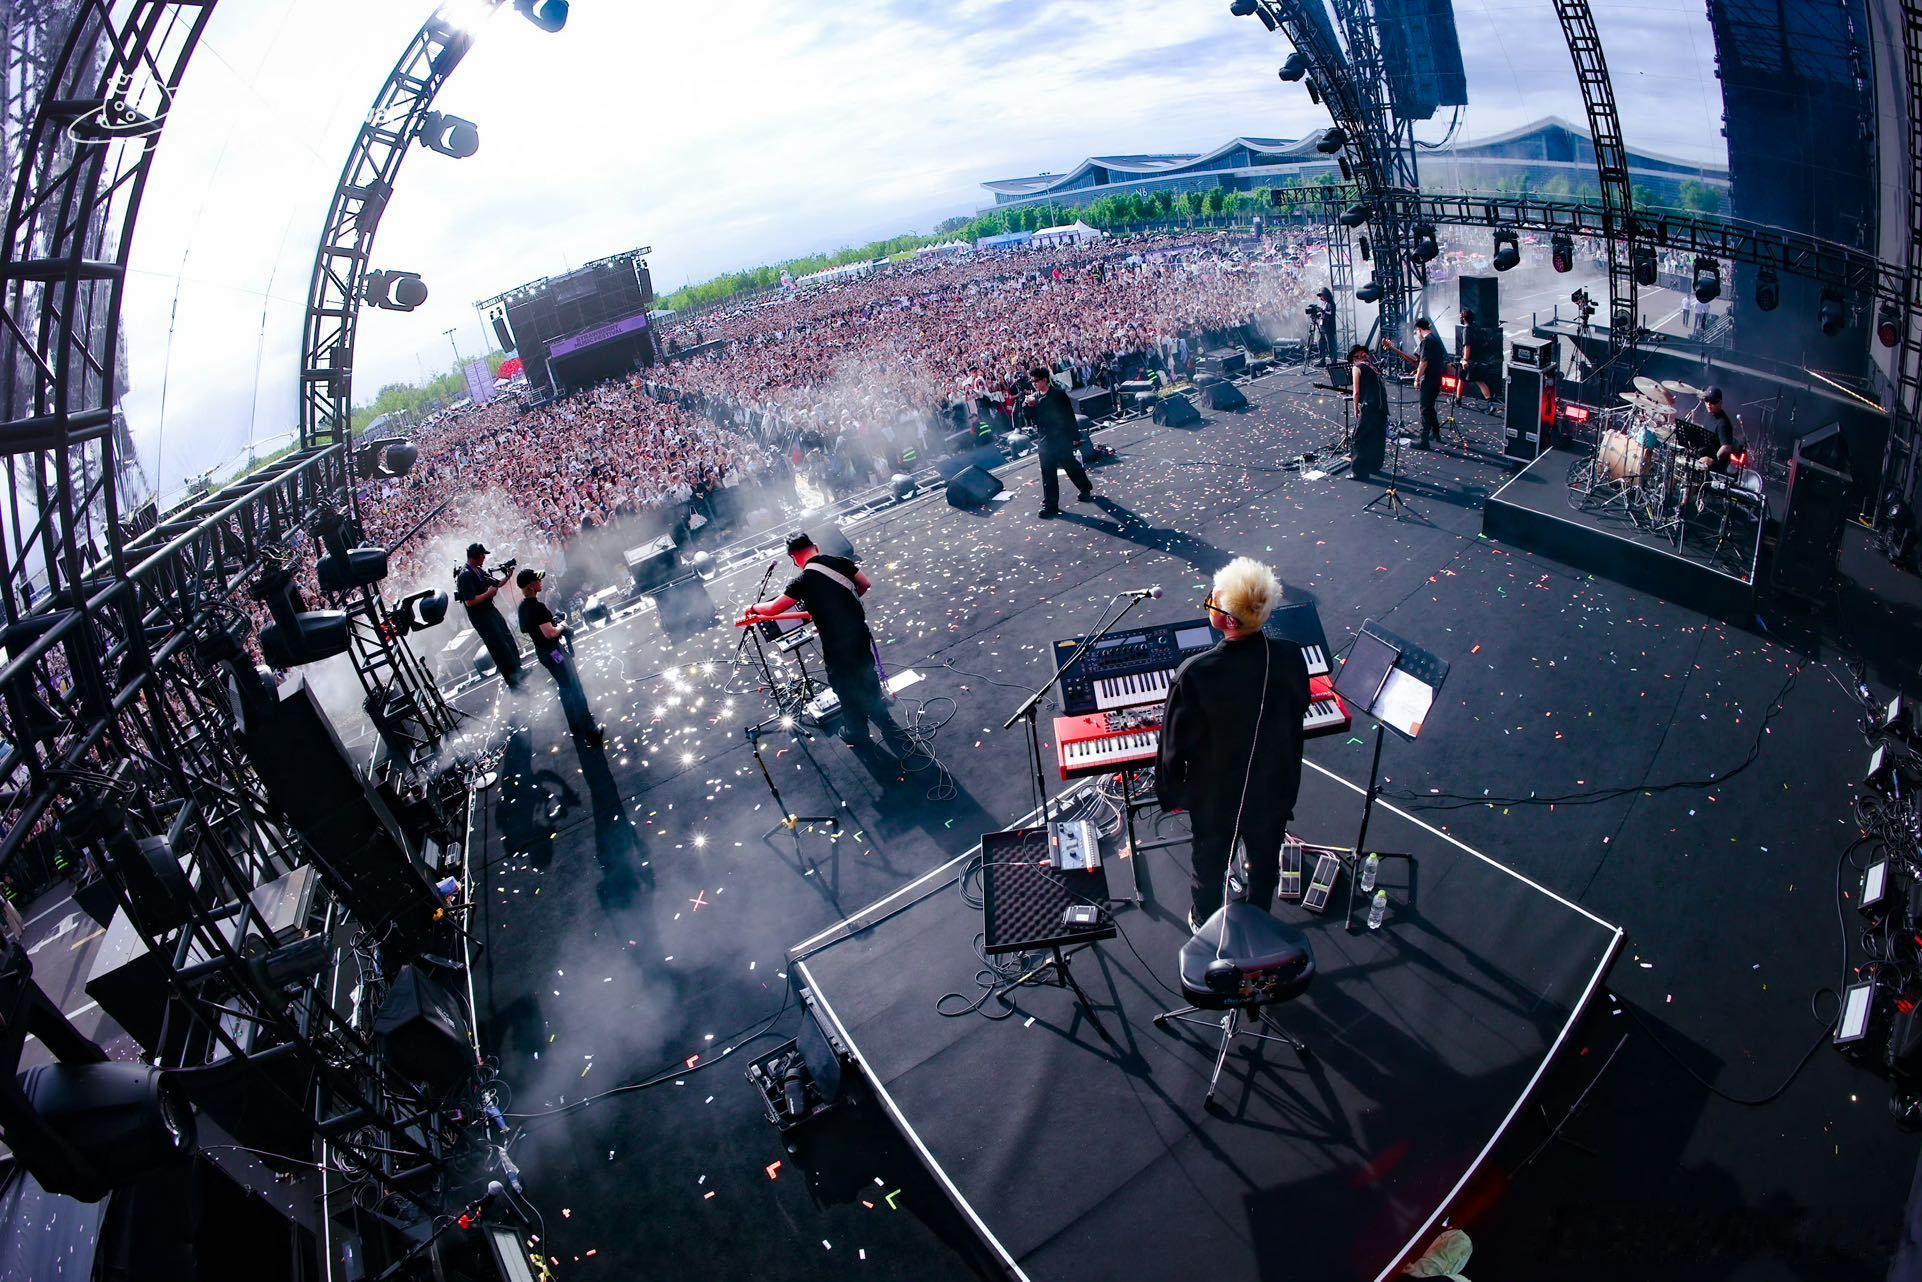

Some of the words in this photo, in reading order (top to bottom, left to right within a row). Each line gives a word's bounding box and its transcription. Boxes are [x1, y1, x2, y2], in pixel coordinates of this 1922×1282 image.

[574, 337, 594, 348] MUSIC
[593, 328, 624, 342] FESTIVAL
[576, 324, 619, 343] STRAWBERRY
